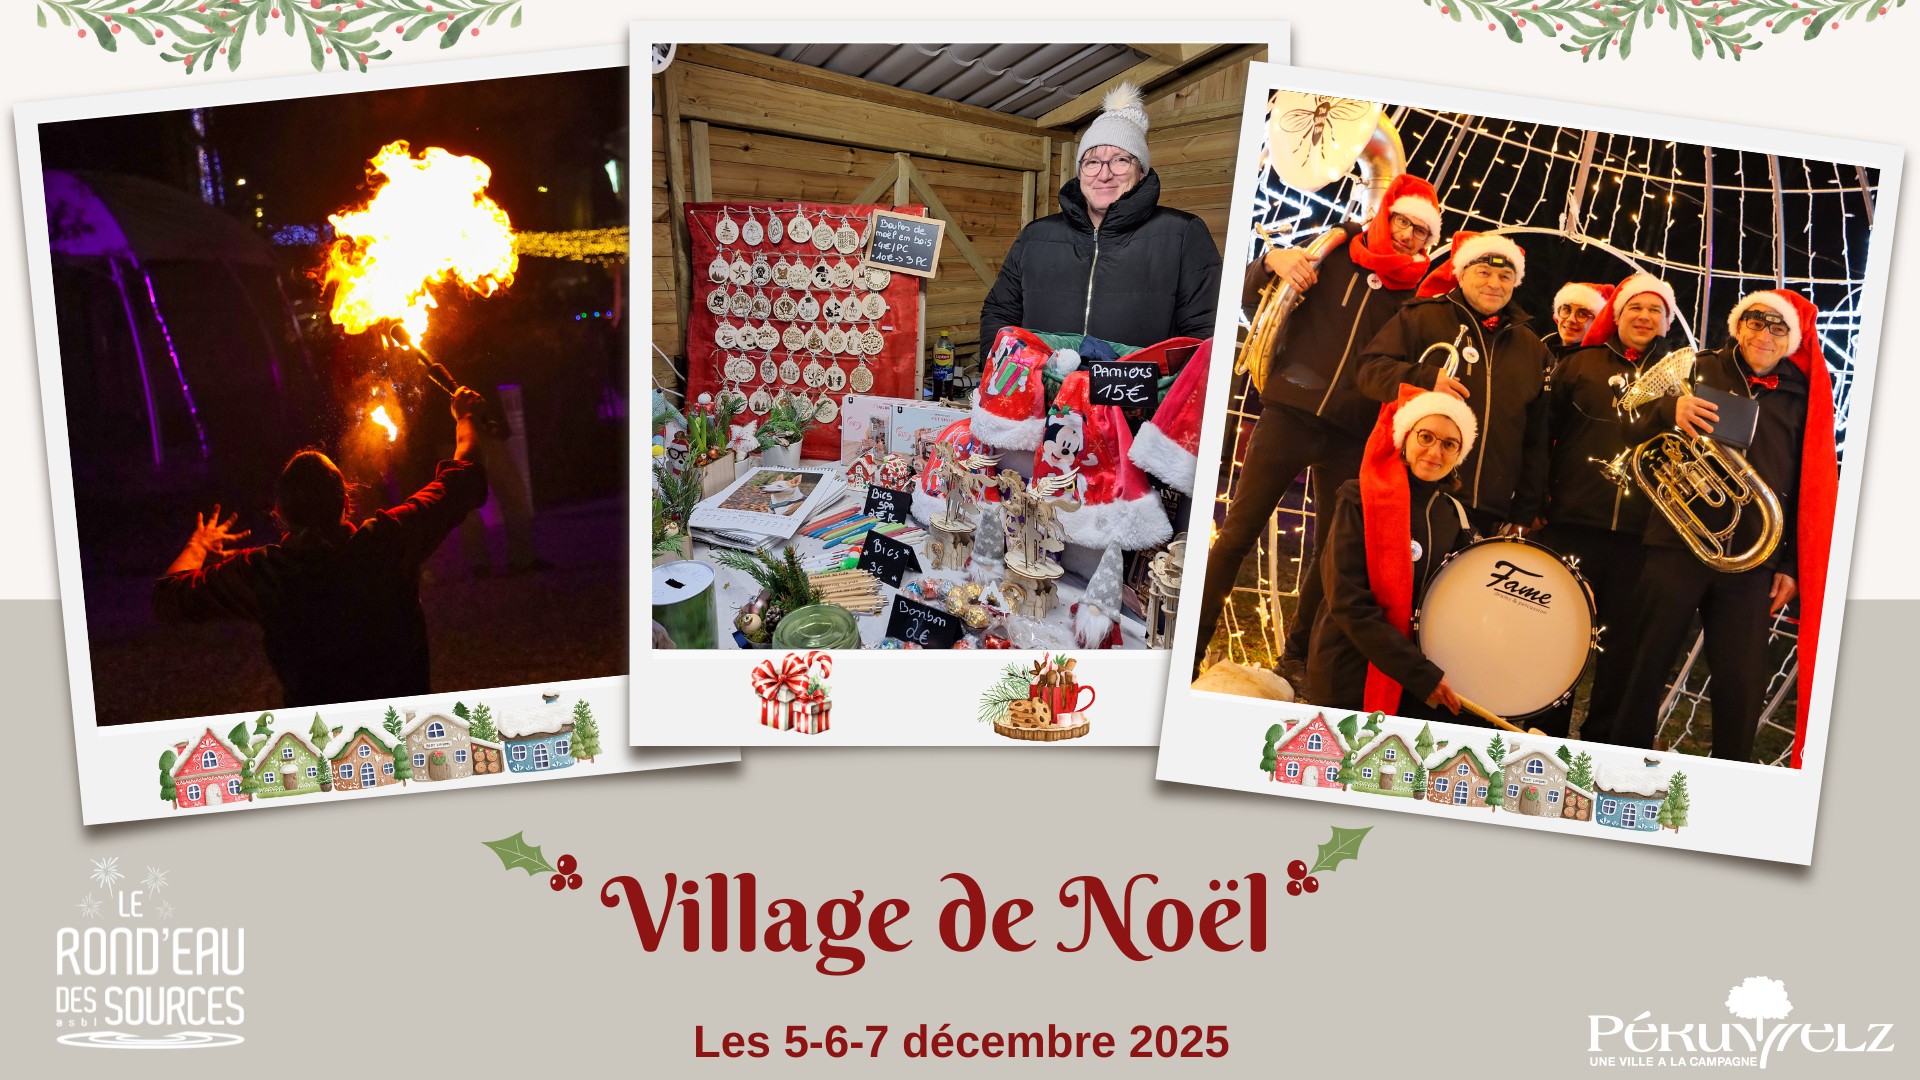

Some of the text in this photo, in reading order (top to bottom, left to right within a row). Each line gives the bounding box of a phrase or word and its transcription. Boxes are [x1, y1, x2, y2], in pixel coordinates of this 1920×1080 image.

[914, 226, 926, 235] de
[914, 235, 932, 246] bois
[916, 257, 927, 266] PC
[1097, 384, 1149, 402] 15€
[871, 488, 893, 500] Bics
[873, 538, 900, 560] Bics
[869, 561, 884, 575] 3€
[1486, 560, 1552, 604] Fame
[906, 618, 930, 645] 2€
